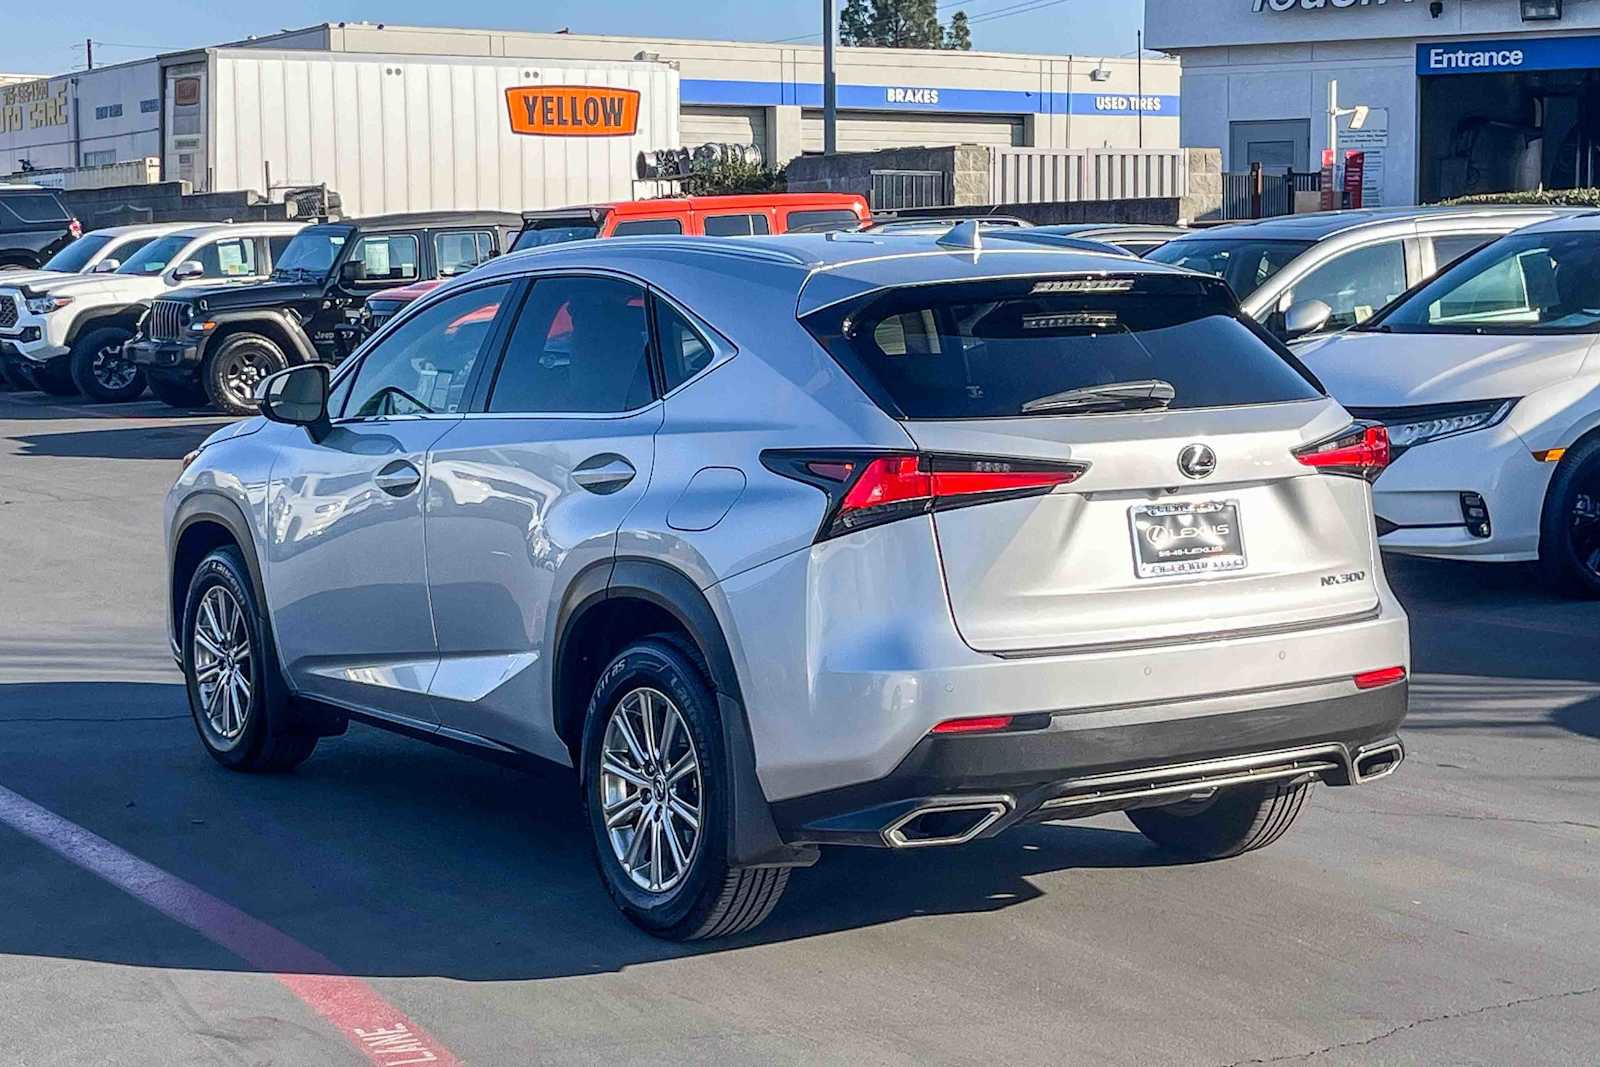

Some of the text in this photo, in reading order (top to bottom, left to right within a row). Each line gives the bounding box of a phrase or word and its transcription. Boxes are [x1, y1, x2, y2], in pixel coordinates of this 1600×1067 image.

[1429, 48, 1523, 69] Entrance
[886, 87, 939, 104] BRAKES
[1095, 96, 1161, 111] USED TIRES
[522, 95, 625, 127] YELLOW
[1169, 524, 1230, 540] LEXUS
